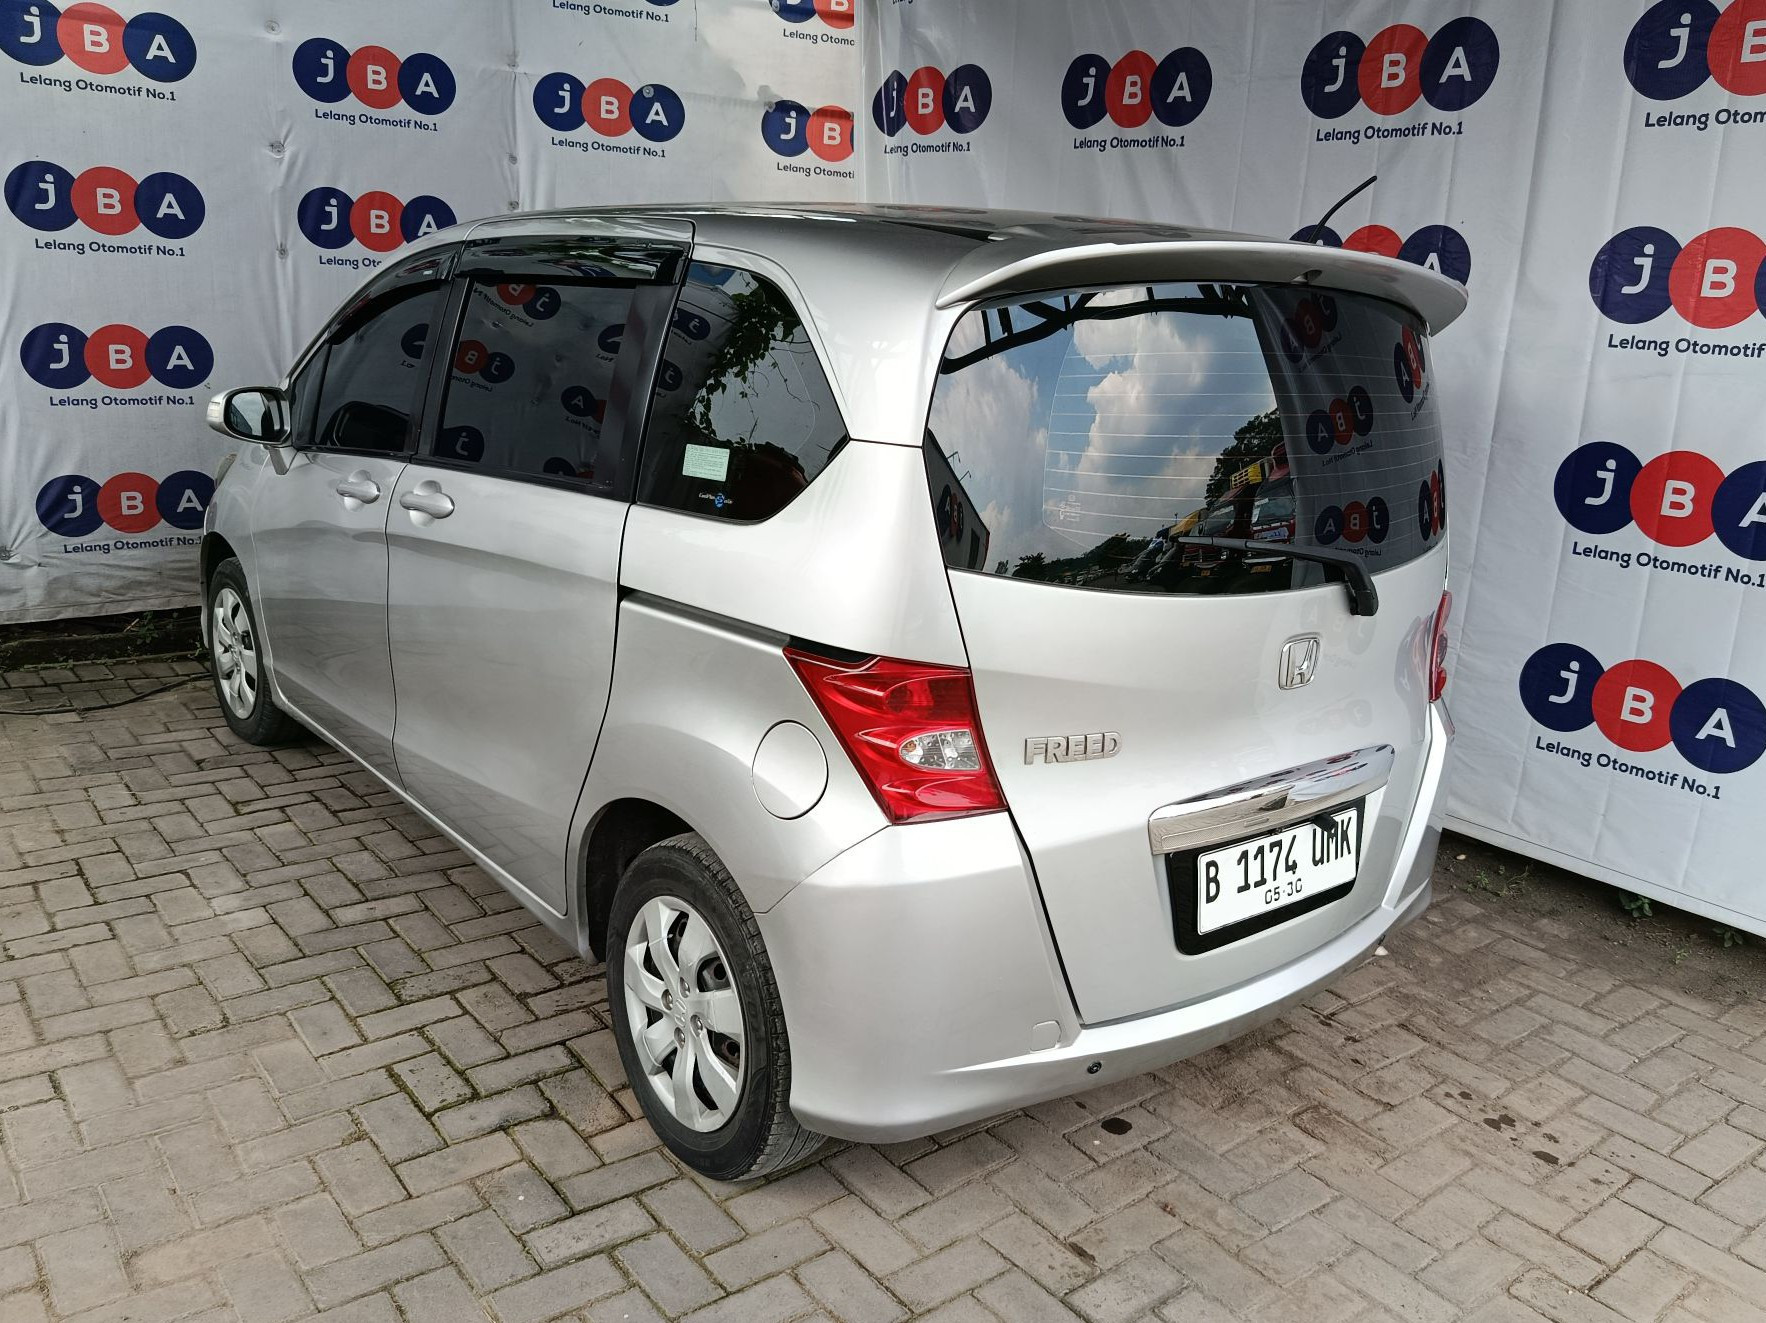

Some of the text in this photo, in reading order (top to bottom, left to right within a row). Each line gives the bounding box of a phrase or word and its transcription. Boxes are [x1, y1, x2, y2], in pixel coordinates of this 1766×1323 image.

[552, 0, 669, 23] Lelang Otomotif No.1
[783, 28, 818, 44] Lelang
[19, 71, 177, 101] Lelang Otomotif No.1
[315, 108, 438, 131] Lelang Otomotif No.1
[1645, 109, 1709, 131] Lelang
[1316, 121, 1463, 144] Lelang Otomotif No.1
[551, 137, 666, 158] Lelang Otomotif No.1
[911, 142, 951, 154] Otomotif
[953, 141, 970, 152] No.1
[1073, 135, 1185, 153] Lelang Otomotif No.1
[776, 161, 811, 177] Lelang
[35, 238, 185, 257] Lelang Otomotif No.1
[319, 256, 359, 270] Lelang
[1608, 334, 1766, 358] Lelang Otomotif
[49, 395, 195, 410] Lelang Otomotif No.1
[63, 541, 111, 556] Lelang
[113, 537, 174, 551] Otomotif
[1572, 542, 1766, 588] Lelang Otomotif No.1
[1024, 731, 1122, 765] FREED
[1536, 736, 1721, 800] Lelang Otomotif No.1
[1205, 859, 1221, 904] B
[1236, 834, 1298, 894] 1174
